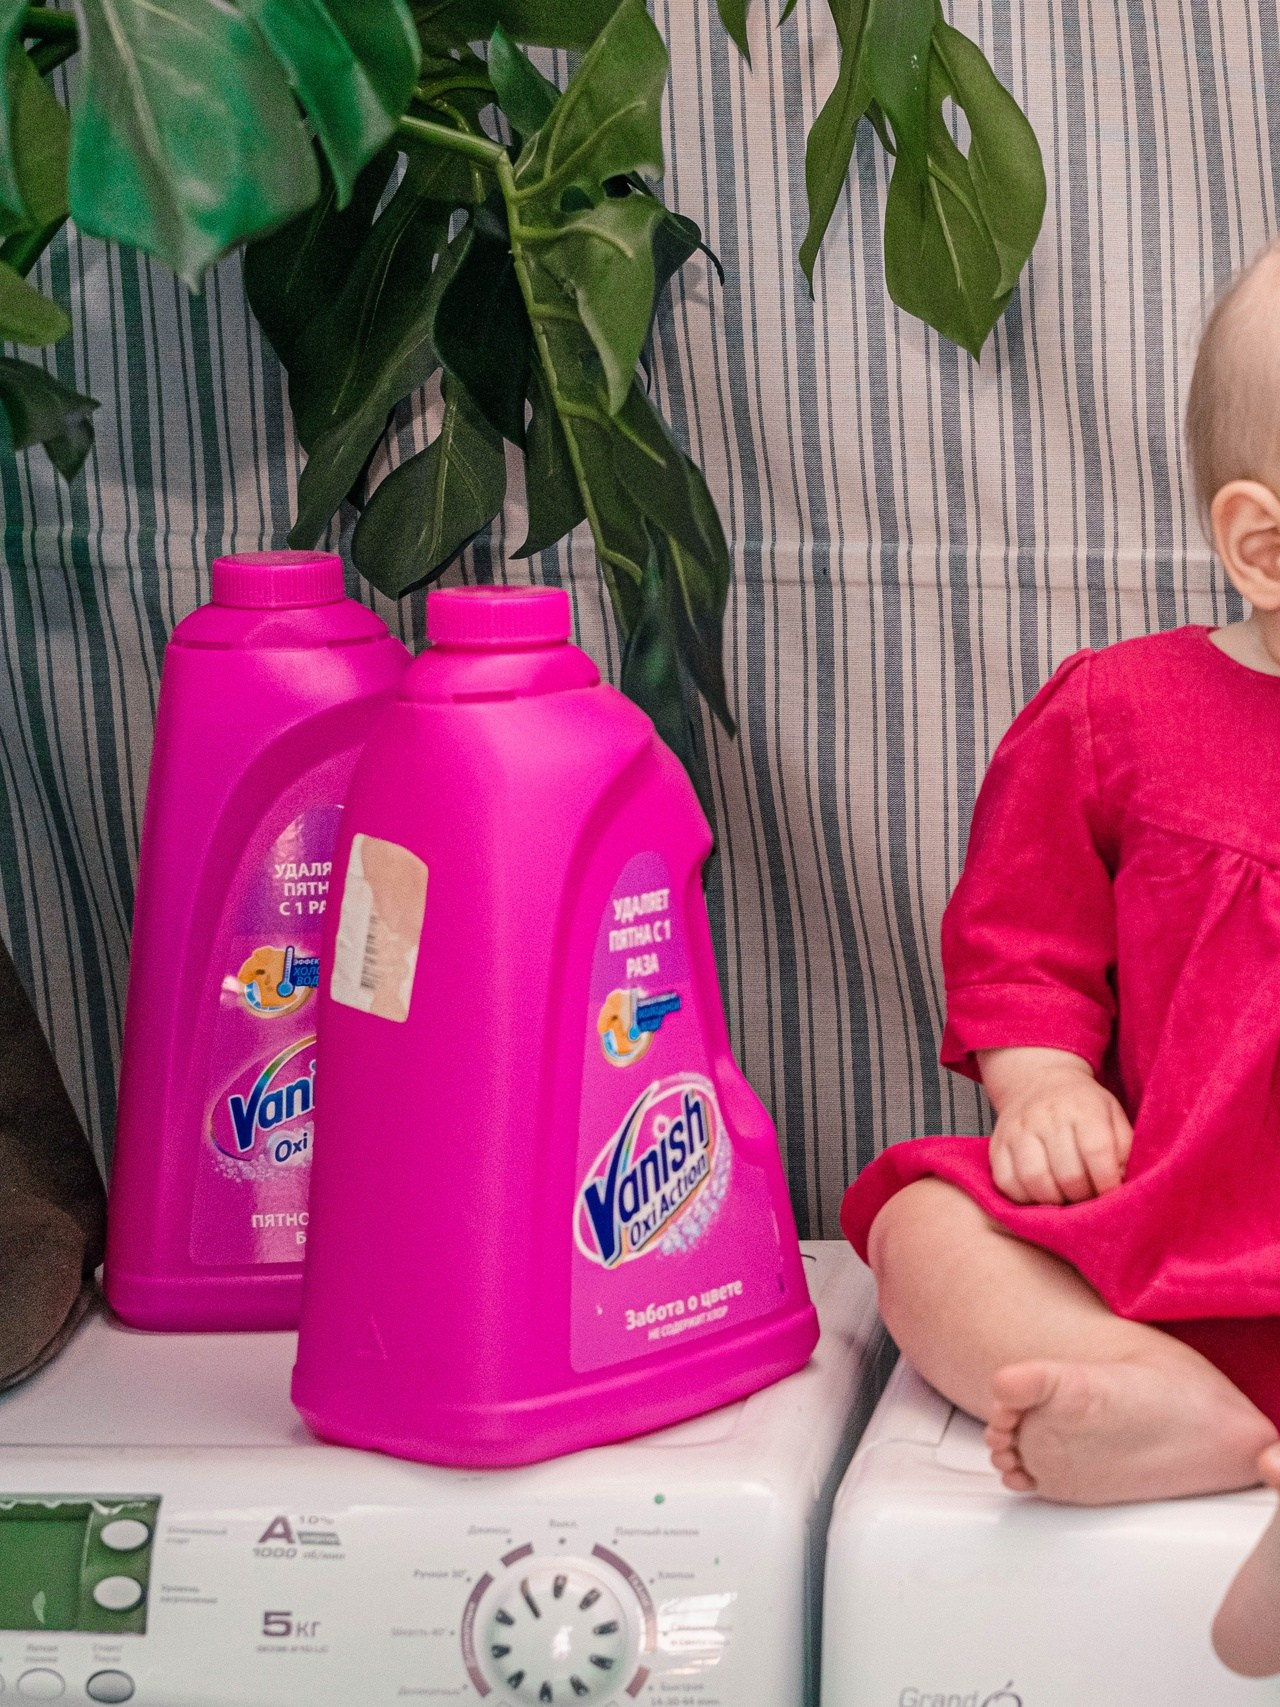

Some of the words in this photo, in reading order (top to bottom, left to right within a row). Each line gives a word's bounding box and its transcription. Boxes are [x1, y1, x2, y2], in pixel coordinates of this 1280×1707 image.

[273, 861, 333, 880] УДАЛЯ
[284, 881, 330, 897] ПЯТН
[279, 901, 291, 916] С
[295, 901, 303, 915] 1
[626, 952, 660, 979] РАЗА
[229, 1060, 317, 1152] Van
[275, 1132, 308, 1163] Oxi
[583, 1088, 708, 1263] Vanish
[624, 1300, 686, 1331] Забота
[687, 1295, 699, 1312] о
[700, 1280, 744, 1309] цвете
[258, 1515, 296, 1544] A
[252, 1547, 297, 1559] 1000
